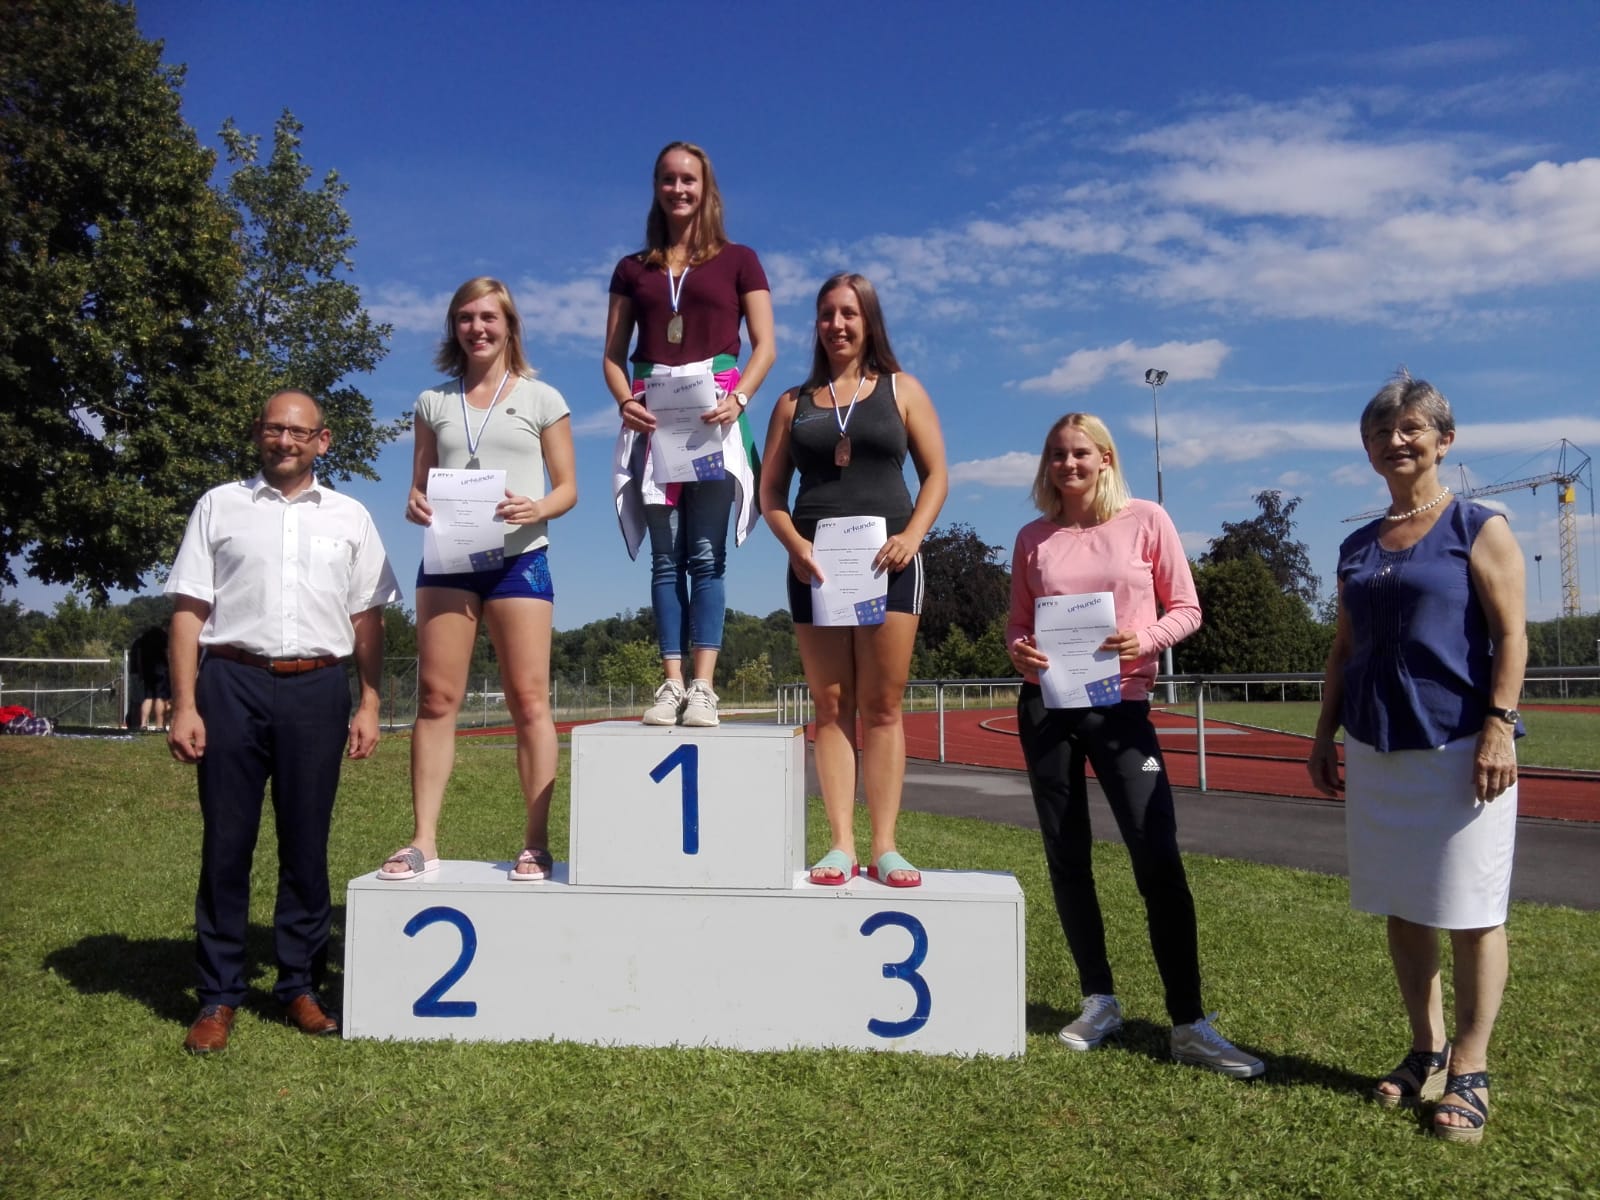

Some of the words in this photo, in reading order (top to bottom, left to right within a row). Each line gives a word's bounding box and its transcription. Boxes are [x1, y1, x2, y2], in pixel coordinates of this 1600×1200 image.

[650, 744, 698, 855] 1
[403, 906, 477, 1017] 2
[860, 911, 931, 1038] 3
